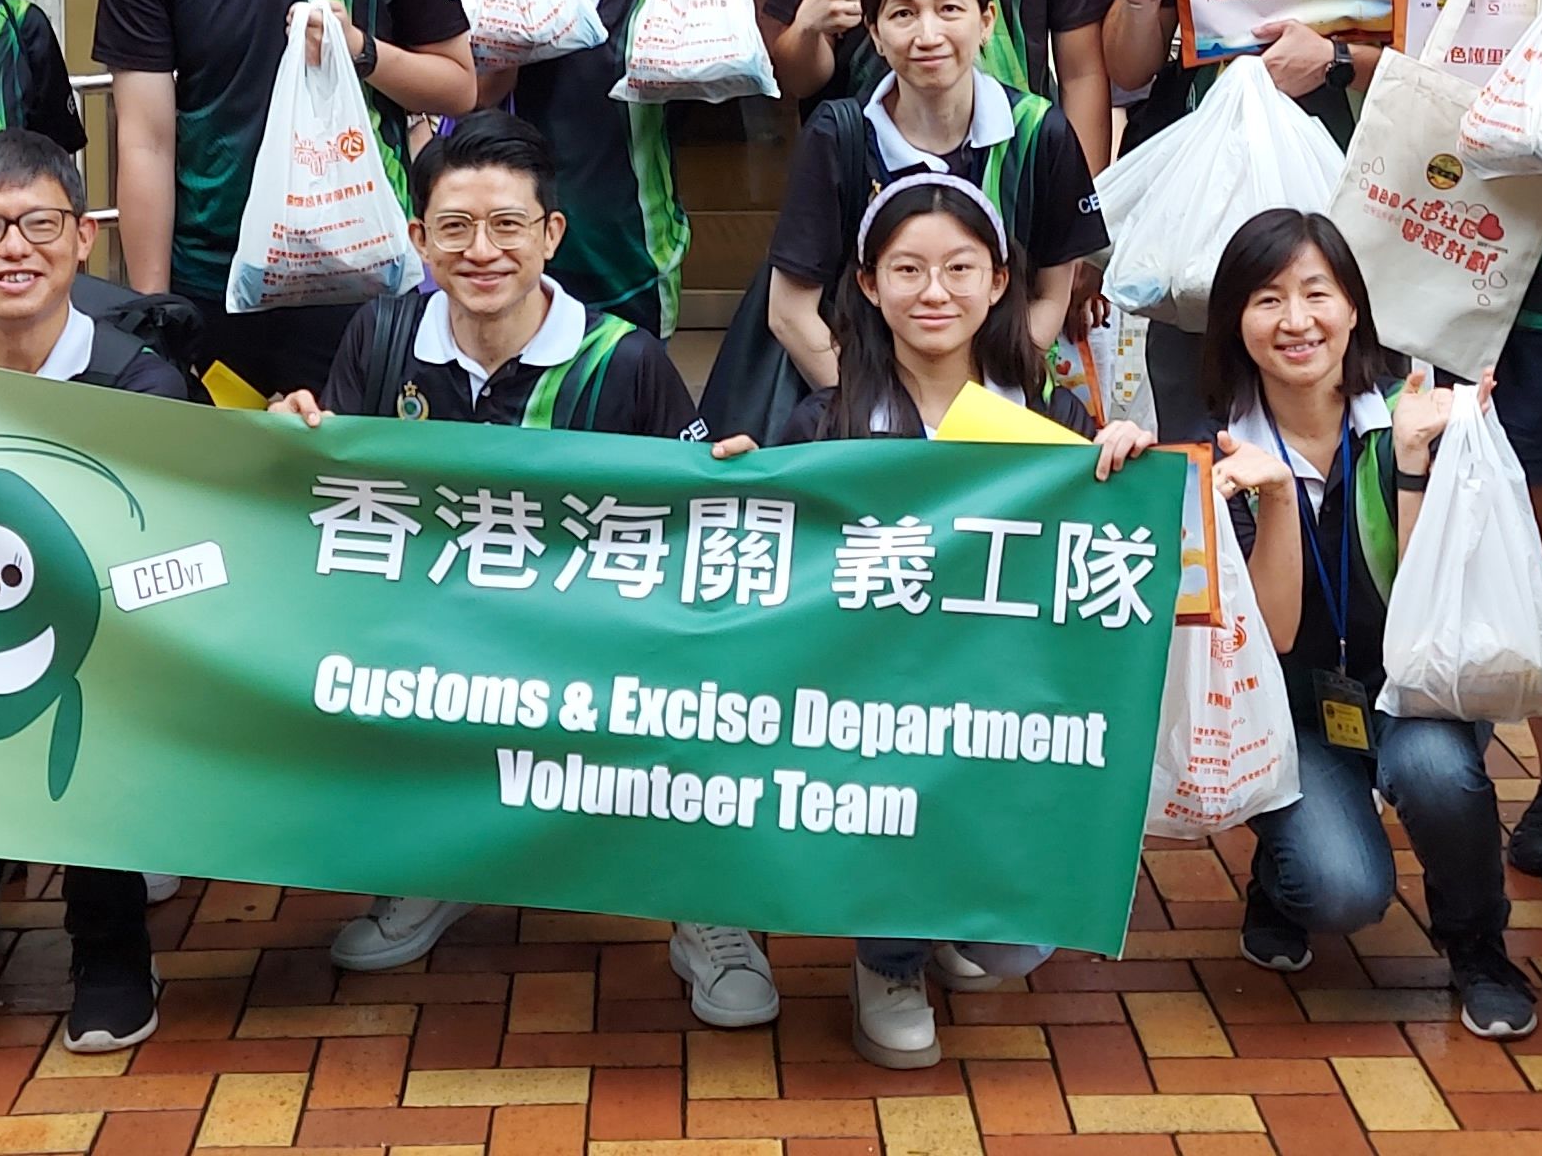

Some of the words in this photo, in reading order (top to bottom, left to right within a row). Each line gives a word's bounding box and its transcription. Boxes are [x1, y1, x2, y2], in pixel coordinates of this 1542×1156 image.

[309, 475, 796, 608] 香港海關
[831, 514, 1157, 630] 義工隊
[313, 654, 552, 729] Customs
[558, 680, 599, 733] &
[608, 675, 782, 746] Excise
[791, 687, 1108, 768] Department
[496, 747, 764, 829] Volunteer
[773, 769, 919, 838] Team
